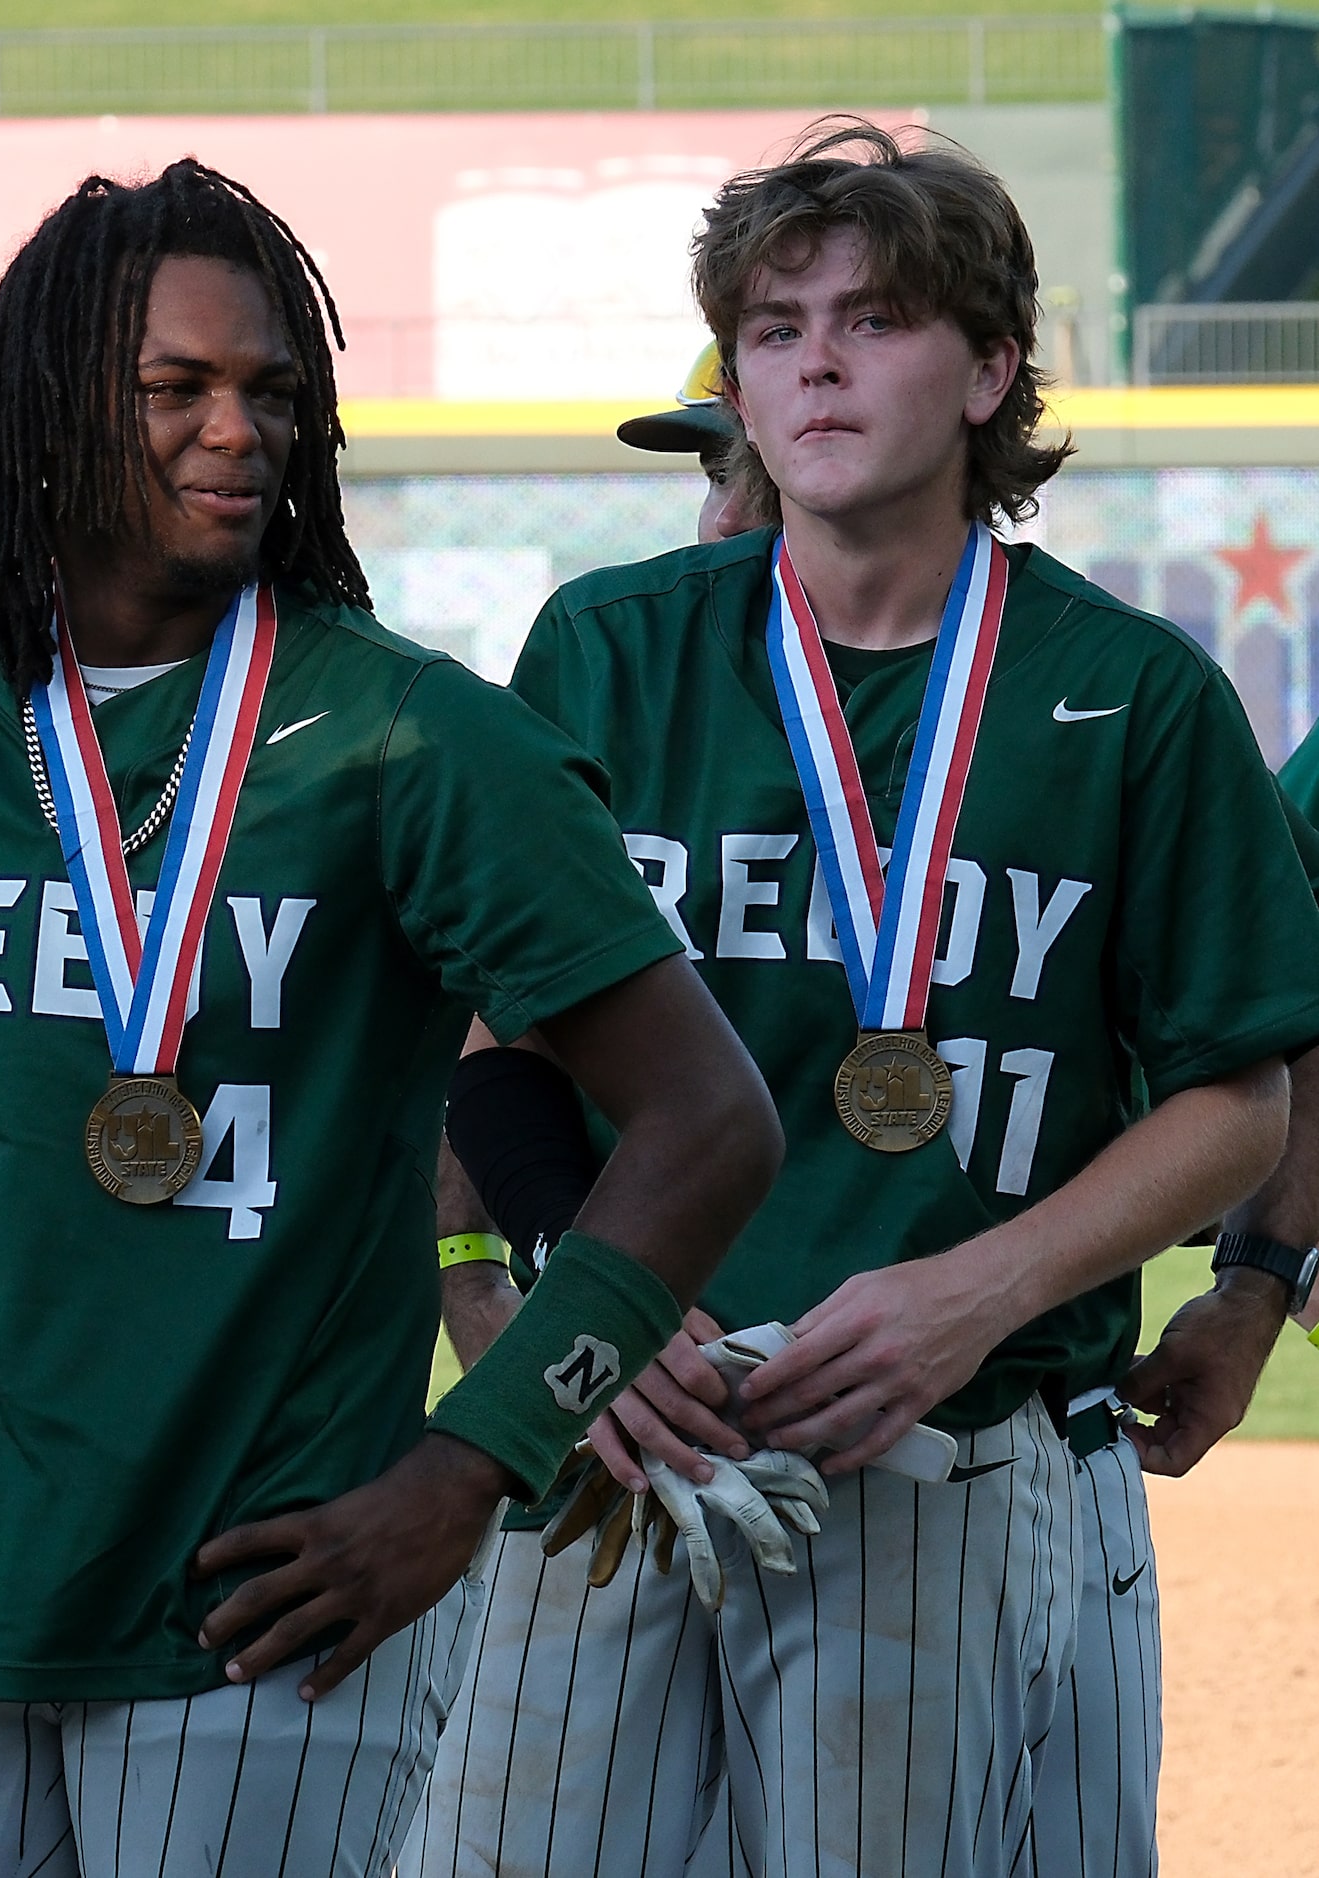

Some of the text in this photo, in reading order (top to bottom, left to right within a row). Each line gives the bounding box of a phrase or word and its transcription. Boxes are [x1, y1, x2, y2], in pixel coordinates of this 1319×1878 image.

[871, 1110, 917, 1126] STATE
[936, 1037, 1055, 1197] 11
[120, 1160, 167, 1177] STATE
[172, 1083, 277, 1239] 4
